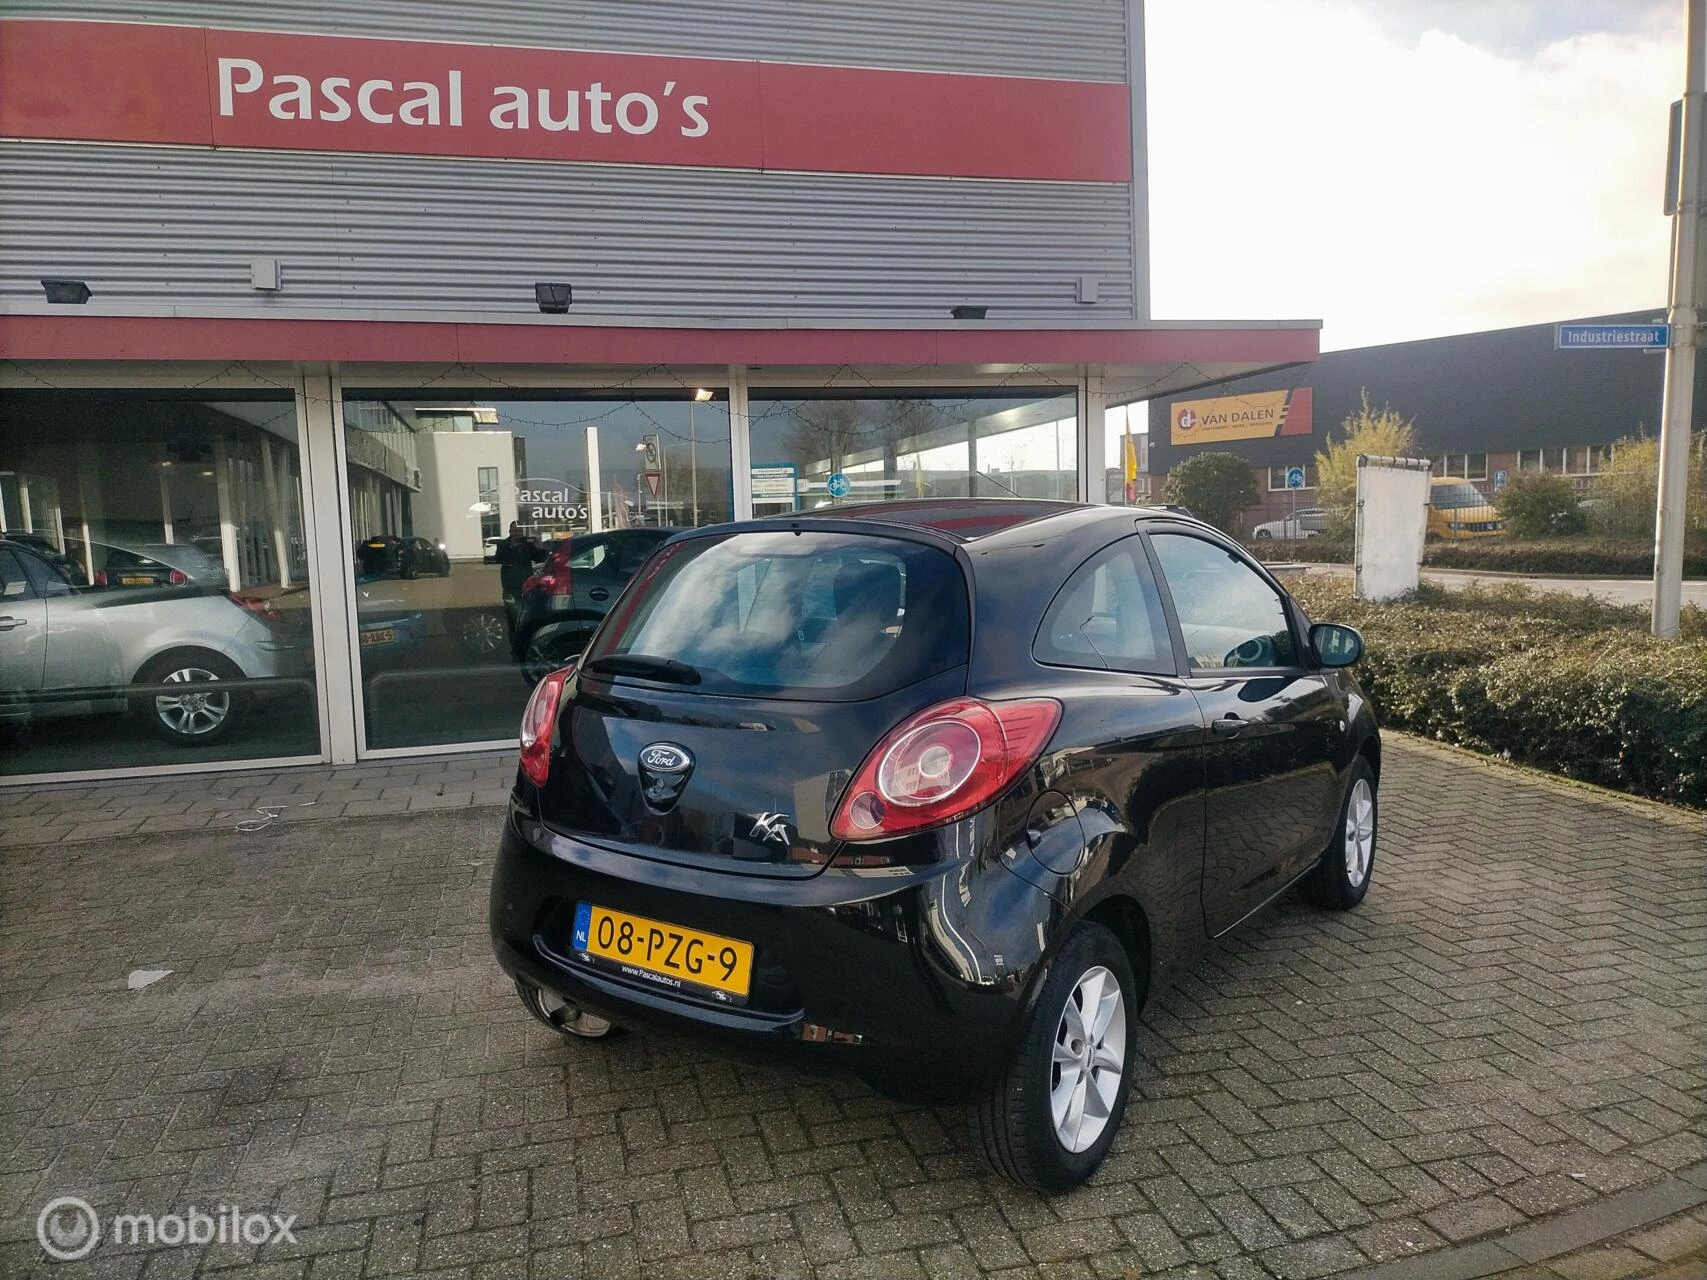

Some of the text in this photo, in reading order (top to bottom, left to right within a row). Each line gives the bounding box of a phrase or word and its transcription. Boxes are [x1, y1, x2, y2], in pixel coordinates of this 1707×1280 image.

[217, 57, 709, 138] Pascal auto's
[1568, 330, 1660, 343] Industriestraat
[1201, 409, 1274, 425] VAN DALEN
[532, 505, 588, 519] auto's
[647, 750, 676, 767] Ford
[576, 930, 587, 942] NL
[597, 915, 738, 982] 08-PZG-9
[621, 965, 682, 988] www.Pascalautos.nl
